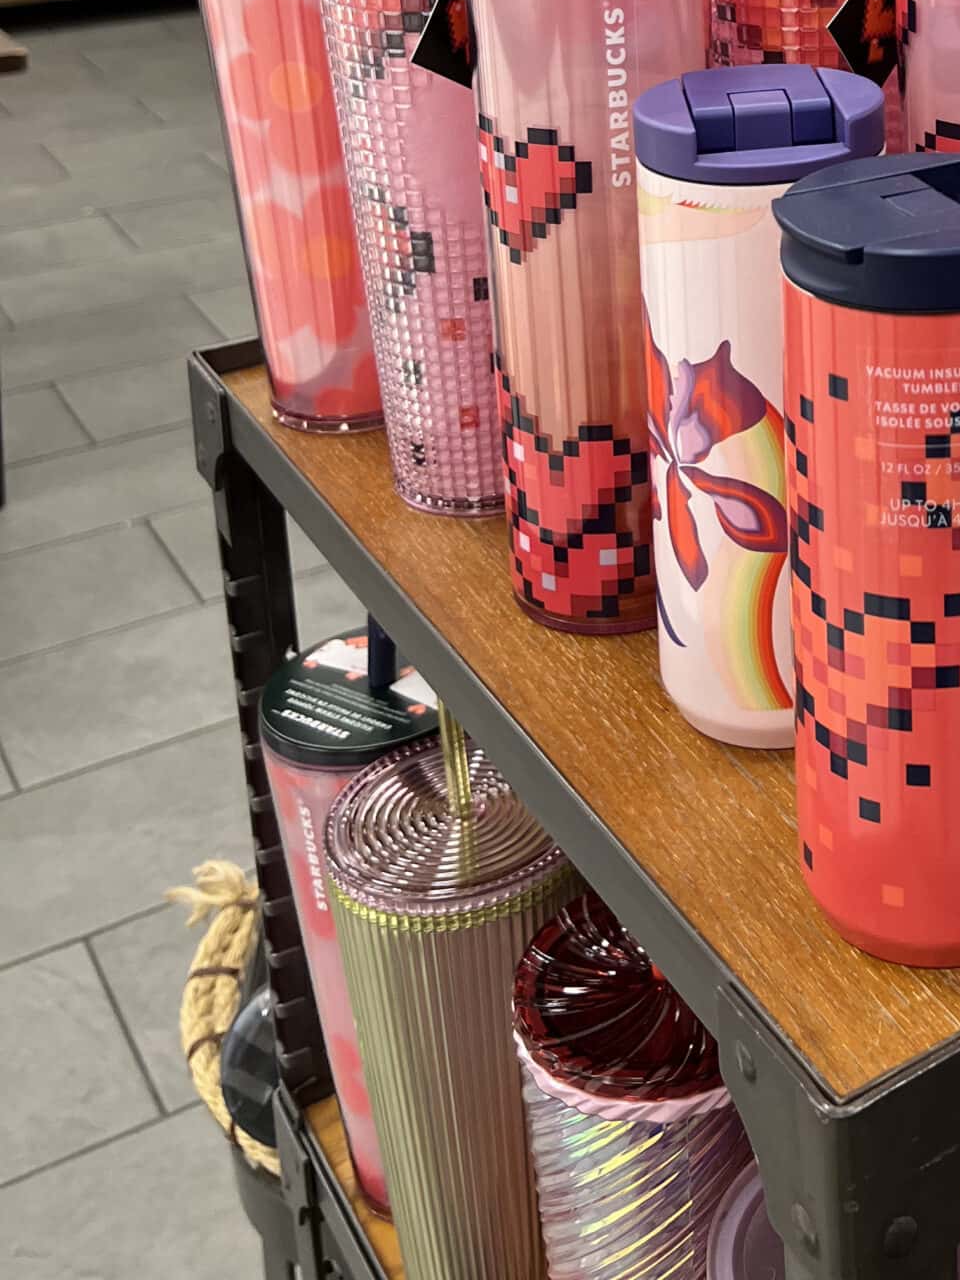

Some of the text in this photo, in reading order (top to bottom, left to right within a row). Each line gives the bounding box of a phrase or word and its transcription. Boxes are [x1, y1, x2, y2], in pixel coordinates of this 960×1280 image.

[603, 6, 632, 188] STARBUCKS
[865, 365, 925, 379] VACUUM
[875, 401, 916, 414] TASSE
[920, 402, 937, 414] DE
[880, 461, 894, 473] 12
[897, 462, 909, 475] FL
[913, 463, 932, 475] OZ
[890, 498, 912, 512] UP
[915, 499, 937, 512] TO
[299, 806, 329, 912] STARBUCKS
